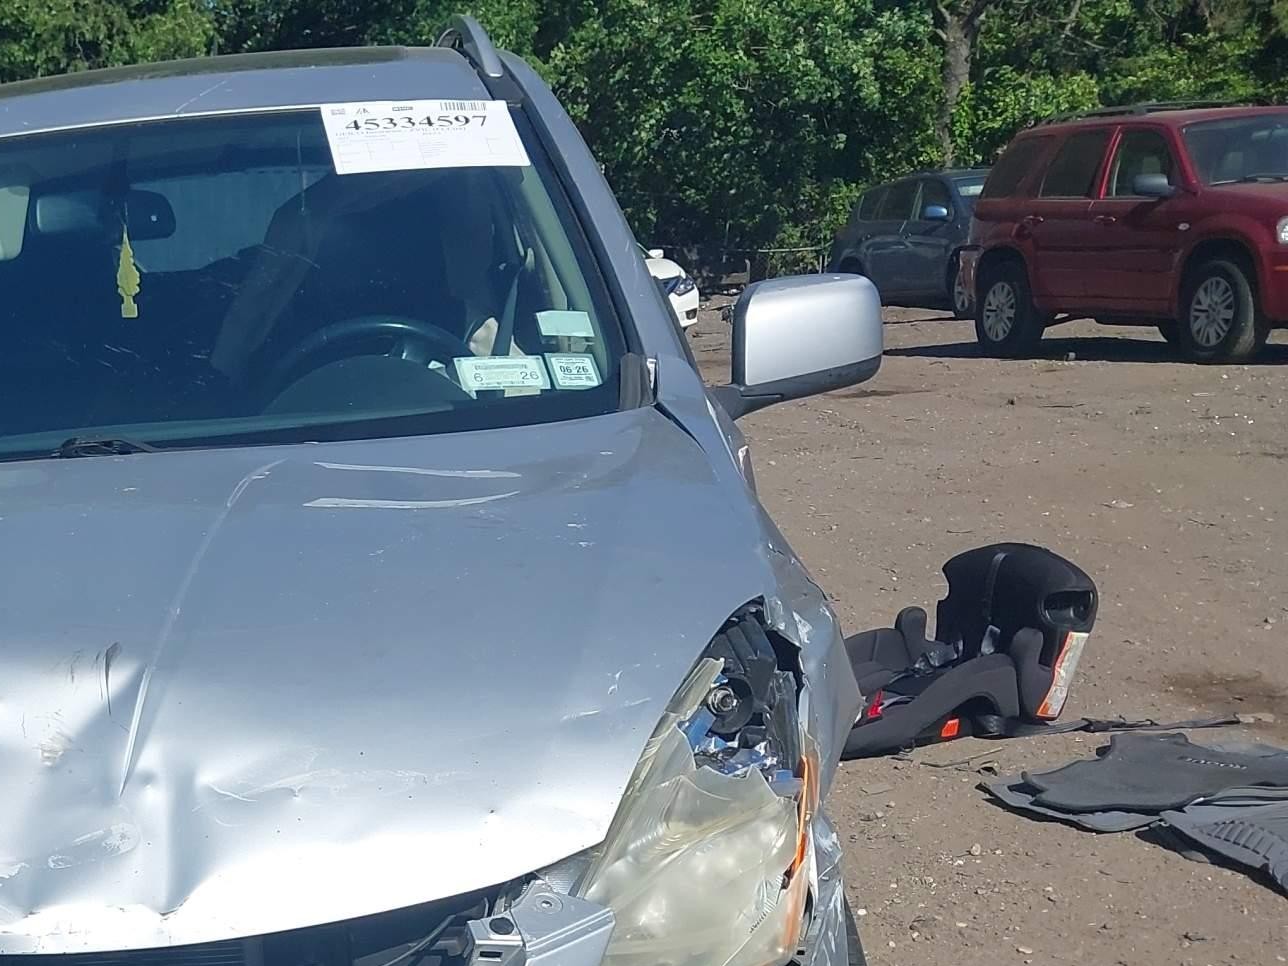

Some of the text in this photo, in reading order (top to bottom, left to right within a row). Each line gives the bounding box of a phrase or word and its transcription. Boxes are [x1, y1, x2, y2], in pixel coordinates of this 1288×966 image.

[345, 115, 487, 131] 45334597
[473, 370, 540, 383] 6 26
